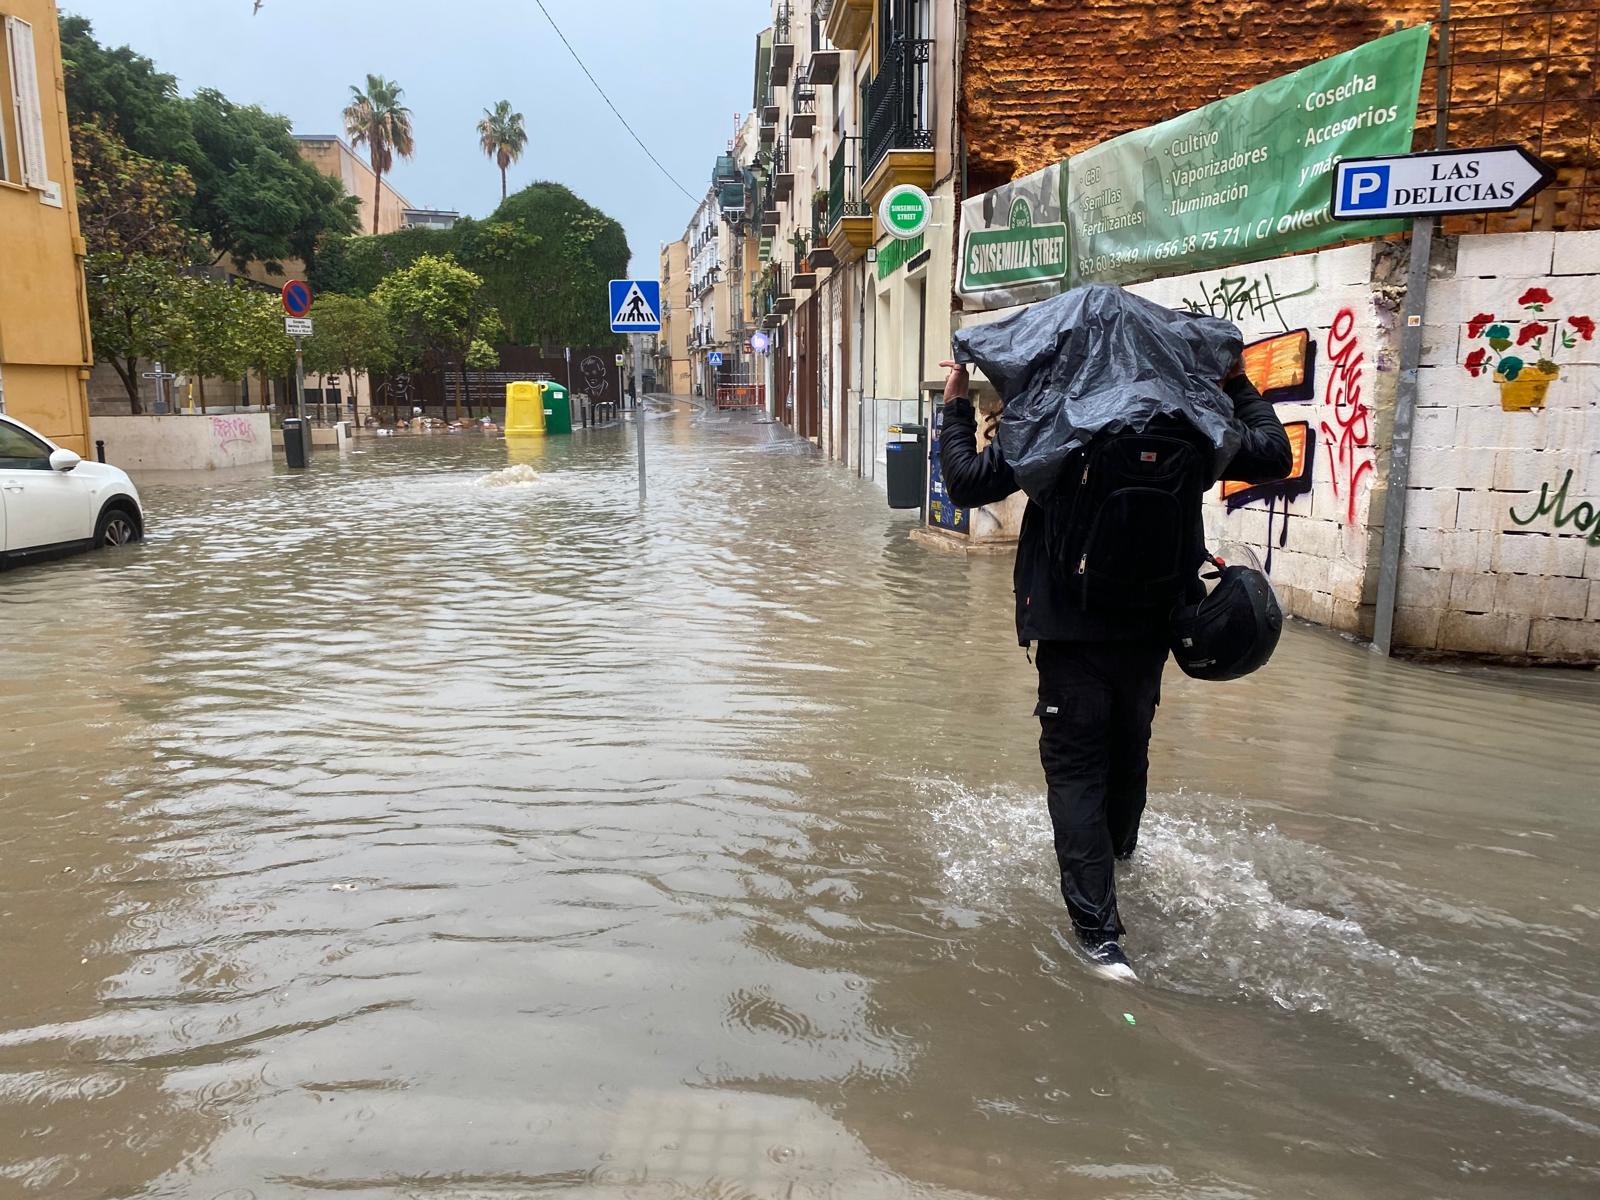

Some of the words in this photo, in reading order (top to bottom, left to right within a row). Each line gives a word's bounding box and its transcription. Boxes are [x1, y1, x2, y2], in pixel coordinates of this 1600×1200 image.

[1305, 74, 1377, 111] Cosecha
[1304, 104, 1398, 147] Accesorios
[1171, 131, 1219, 157] Cultivo
[1084, 167, 1101, 187] CBD
[1172, 146, 1268, 187] Vaporizadores
[1299, 165, 1311, 188] y
[1430, 160, 1480, 181] LAS
[1083, 188, 1122, 212] Semillas
[1170, 182, 1249, 217] Iluminación
[1350, 172, 1382, 205] P
[1393, 181, 1515, 206] DELICIAS
[1081, 211, 1143, 237] Fertilizantes
[1079, 258, 1094, 277] 952
[1096, 255, 1107, 272] 60
[1109, 252, 1121, 269] 33
[1154, 239, 1180, 260] 656
[1180, 234, 1197, 255] 58
[1200, 230, 1218, 251] 75
[1221, 225, 1241, 247] 71
[1255, 217, 1274, 239] C/
[1277, 201, 1334, 234] Ollerí
[969, 239, 1031, 275] SINSEMILLA
[1032, 236, 1064, 267] STREET
